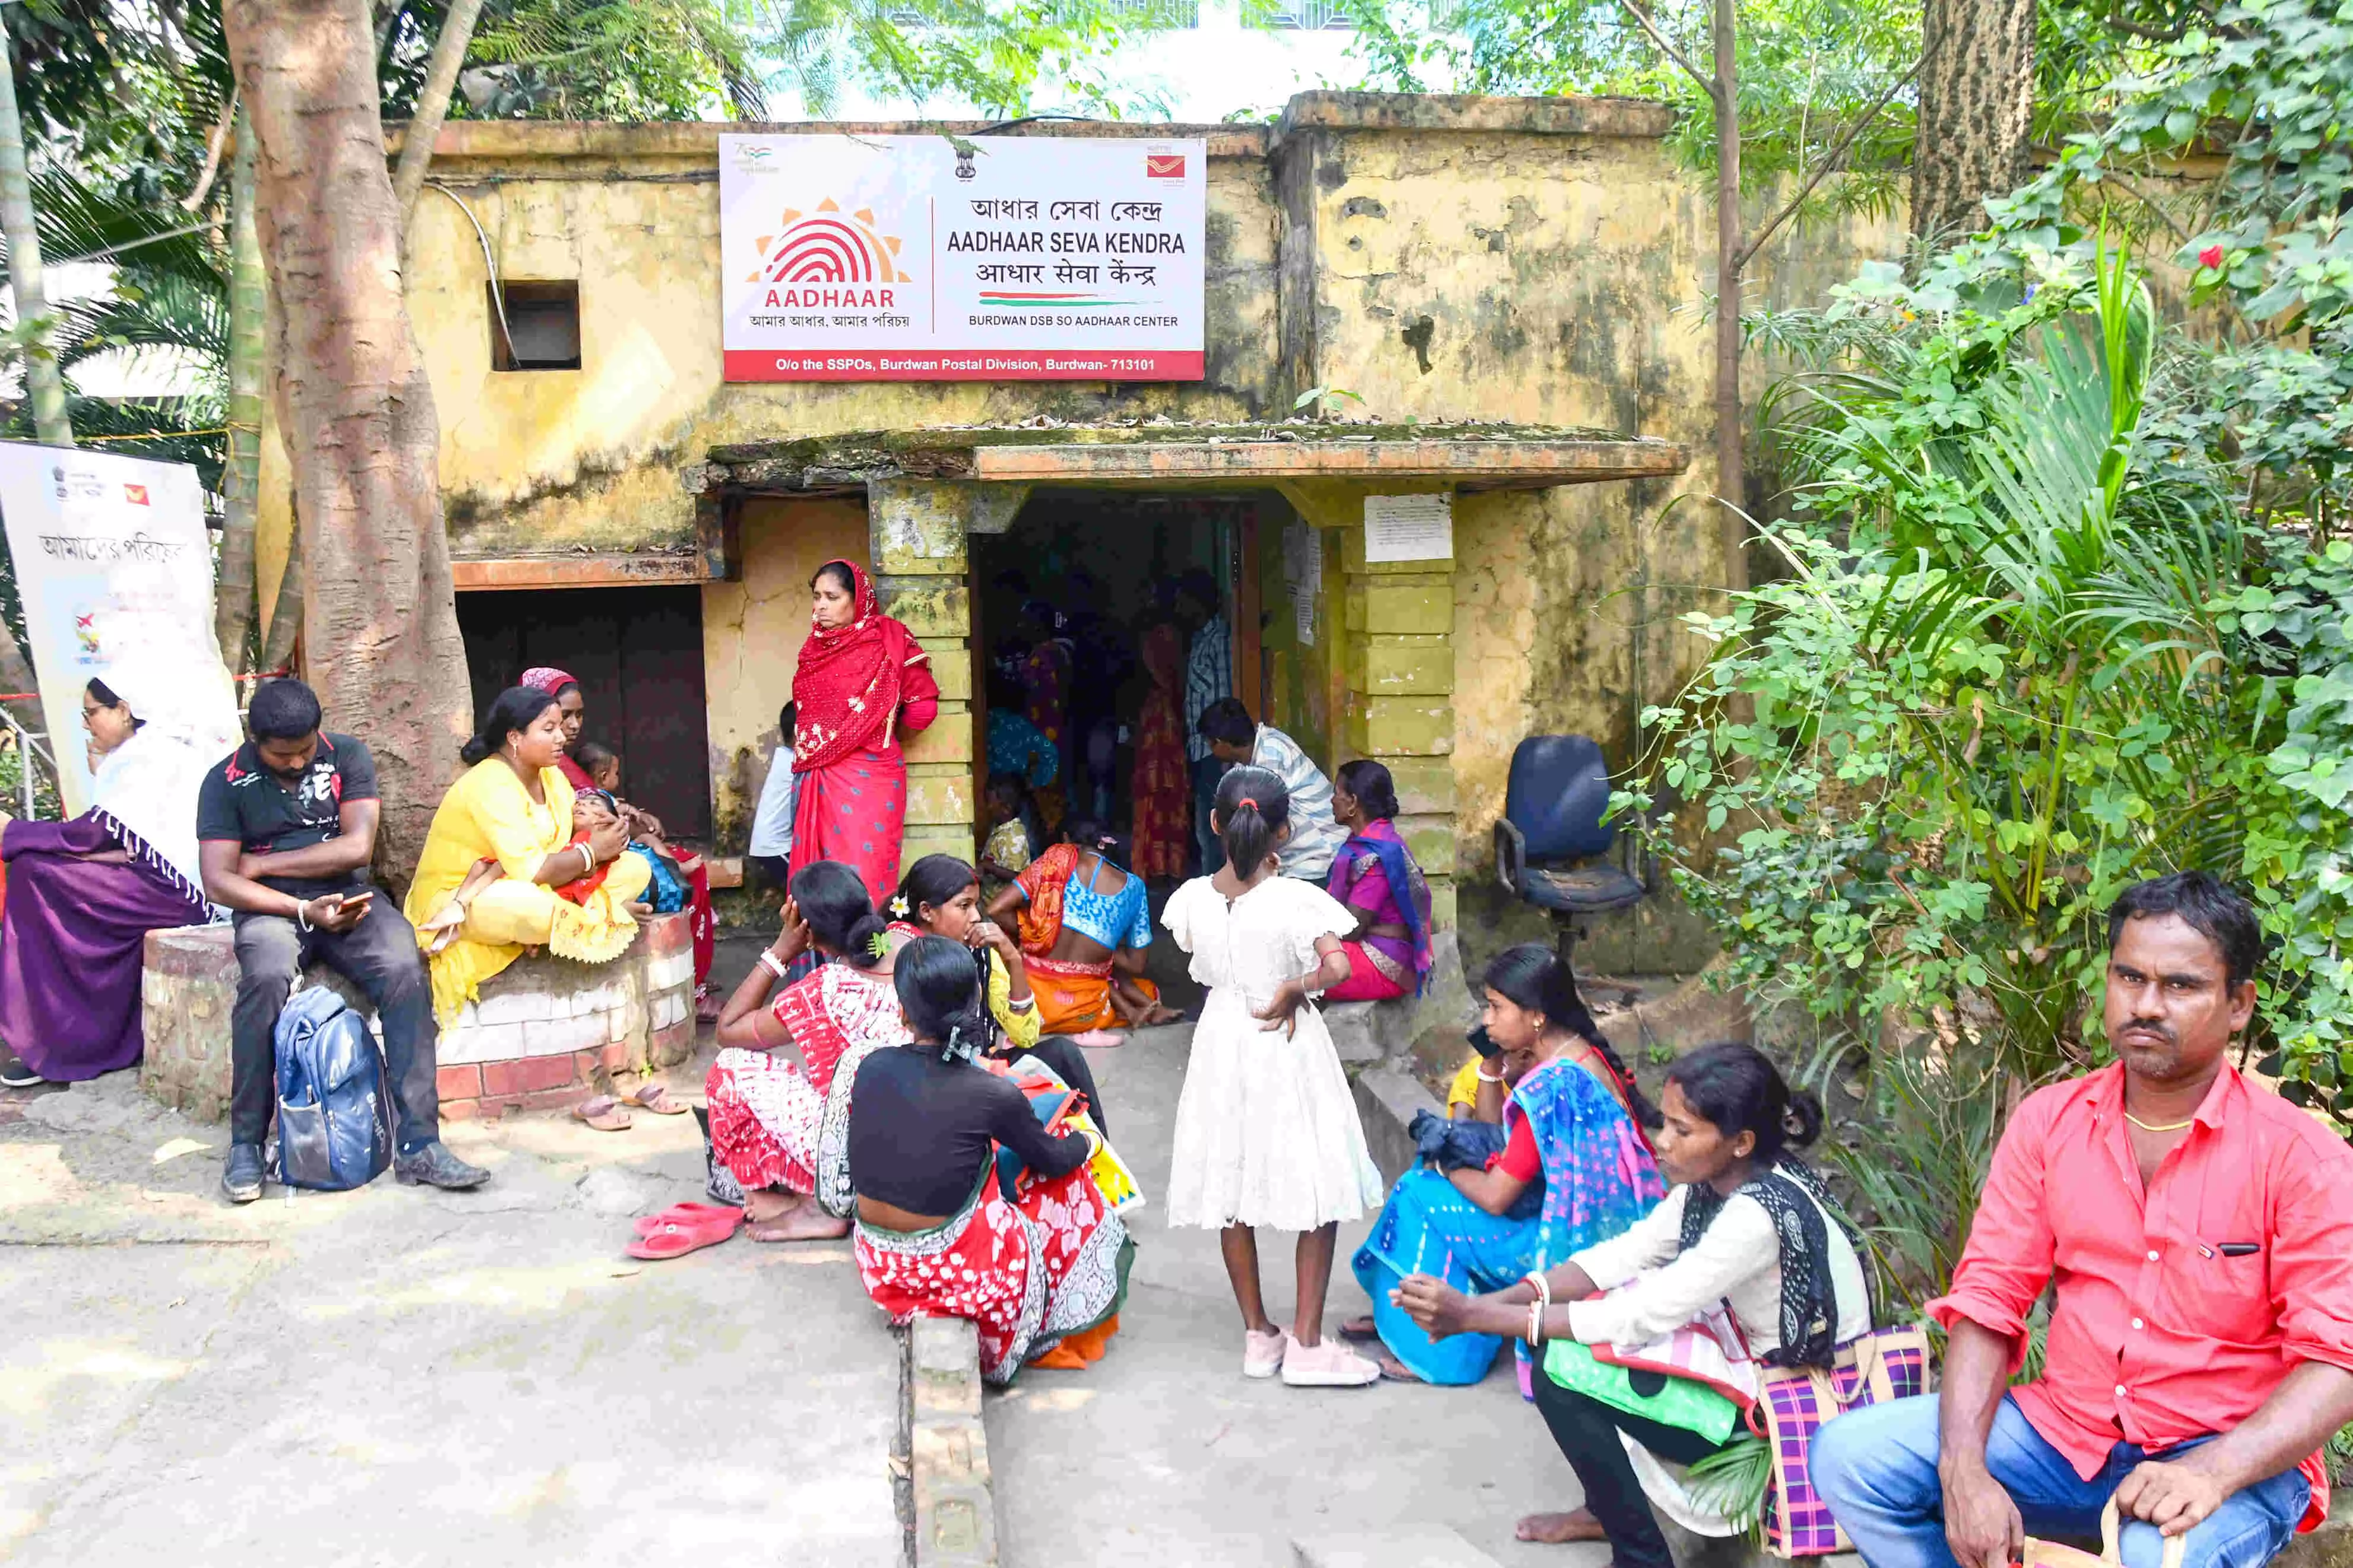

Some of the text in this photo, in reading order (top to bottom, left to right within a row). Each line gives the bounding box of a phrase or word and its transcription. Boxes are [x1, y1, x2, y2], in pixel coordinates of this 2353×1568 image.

[970, 198, 1163, 223] আধার সেবা কেন্দ্র
[947, 231, 1186, 254] AADHAAR SEVA KENDRA
[976, 264, 1046, 284] आधार
[1052, 257, 1100, 284] सेवा
[765, 289, 894, 308] AADHAAR
[749, 311, 910, 328] আমার আধার, আমার পরিচয়
[968, 315, 1178, 327] BURDWAN DSB SO AADHAAR CENTER
[776, 358, 1154, 371] O/o the SSPOs, Burdwan Postal Division, Burdwan- 713101
